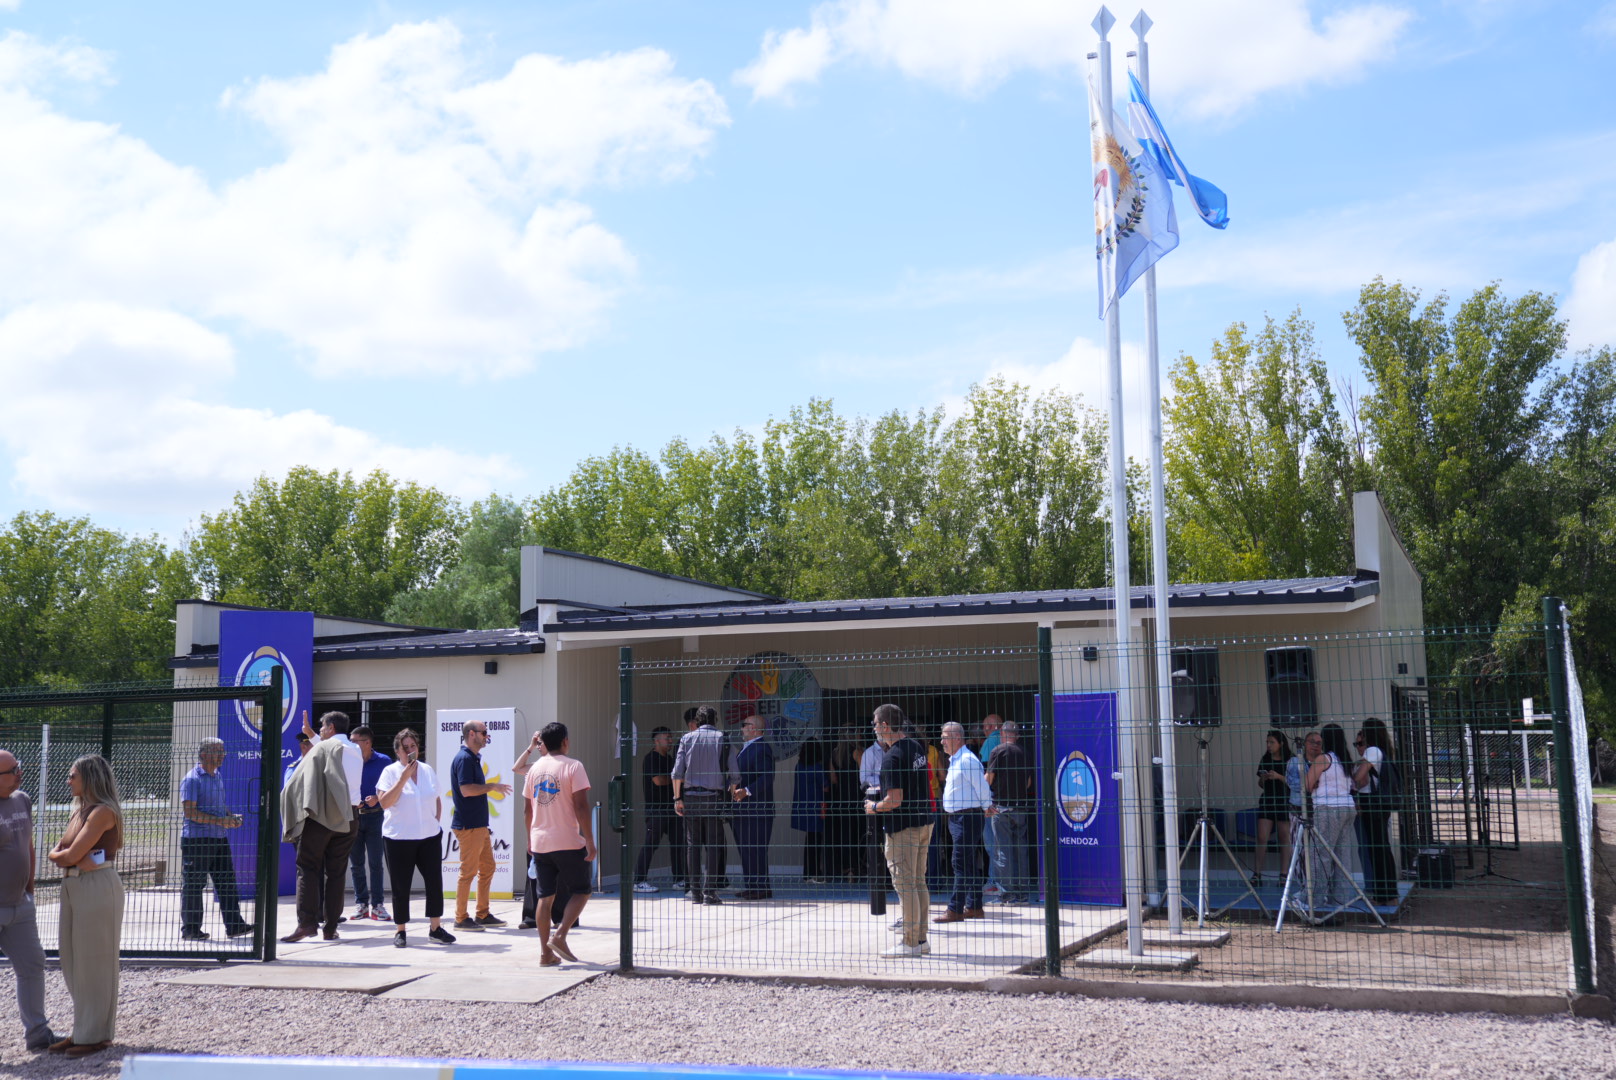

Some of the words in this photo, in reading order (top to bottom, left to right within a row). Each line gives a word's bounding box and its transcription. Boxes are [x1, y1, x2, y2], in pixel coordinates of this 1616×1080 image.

[758, 700, 781, 715] EEI
[489, 720, 510, 731] OBRAS
[237, 749, 293, 760] MENZA
[1059, 837, 1099, 846] MENDOZA
